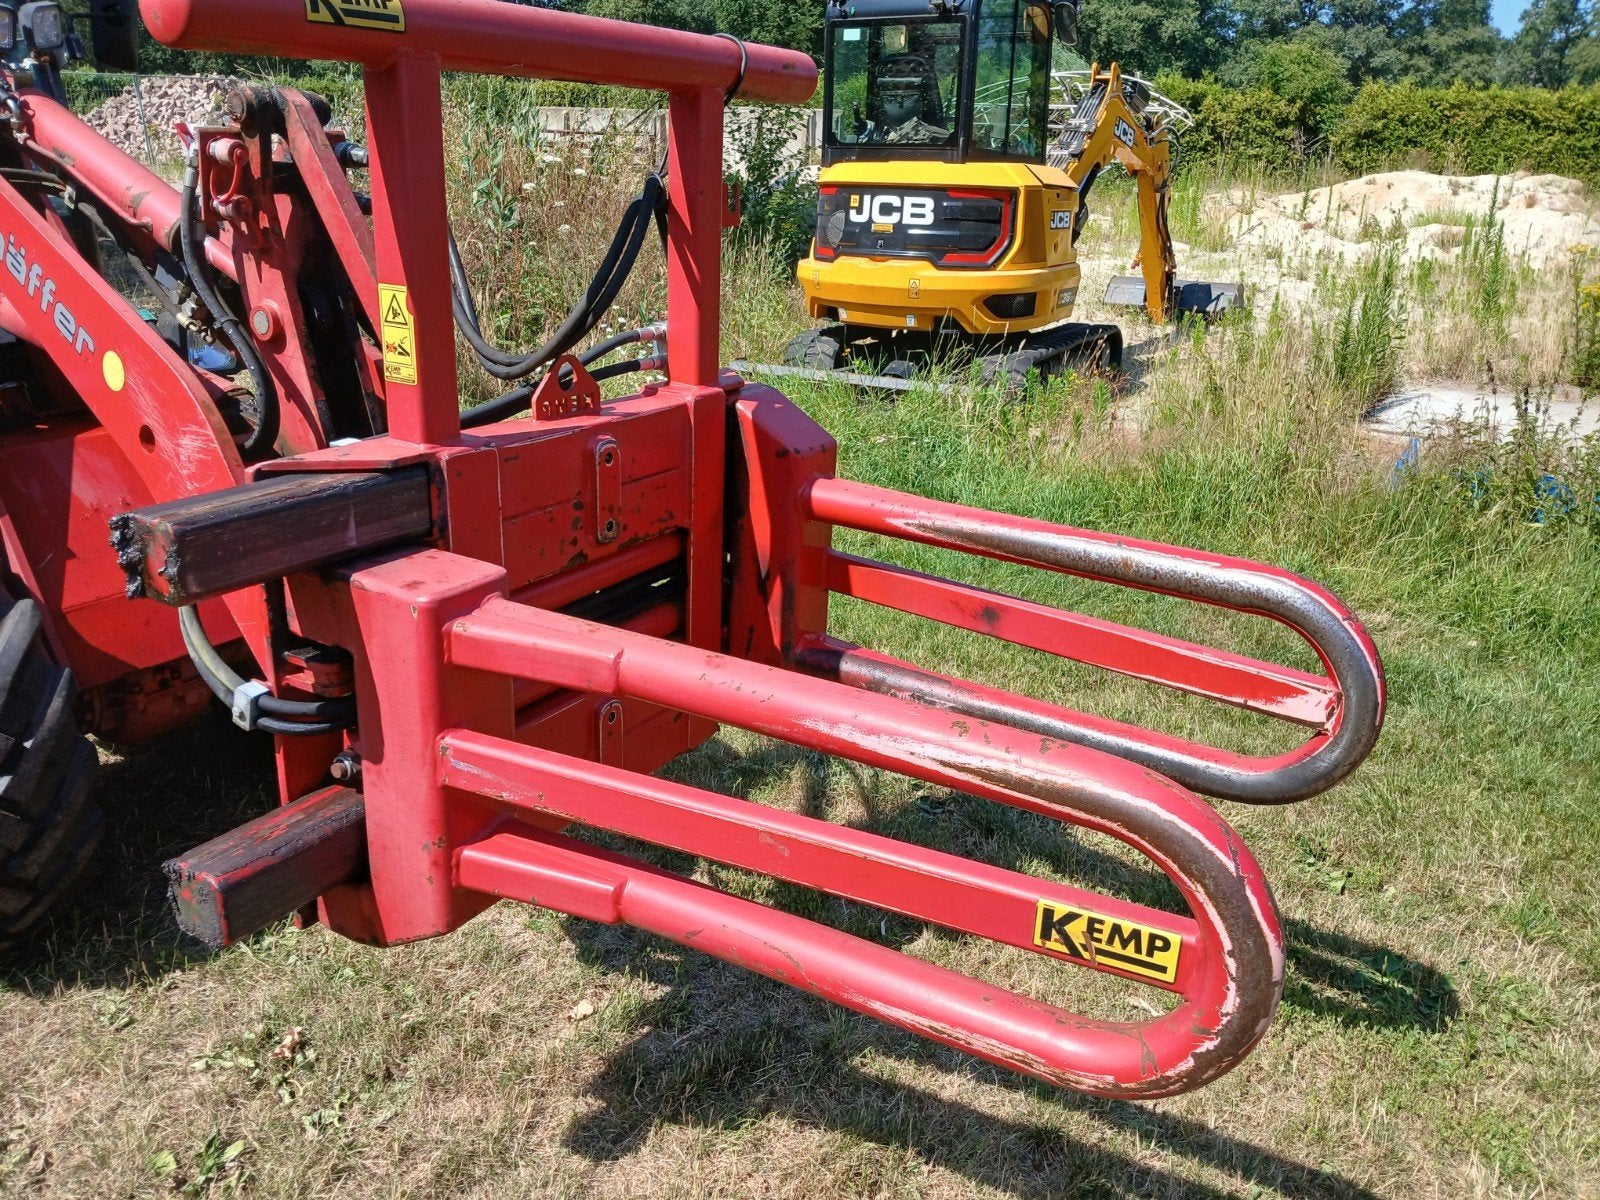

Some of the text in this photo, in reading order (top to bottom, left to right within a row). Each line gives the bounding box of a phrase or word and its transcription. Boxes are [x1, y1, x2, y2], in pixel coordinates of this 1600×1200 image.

[1115, 117, 1134, 148] JCB
[849, 194, 935, 226] JCB
[1050, 211, 1070, 230] JCB
[0, 231, 95, 355] äffer
[1040, 907, 1172, 958] KEMP
